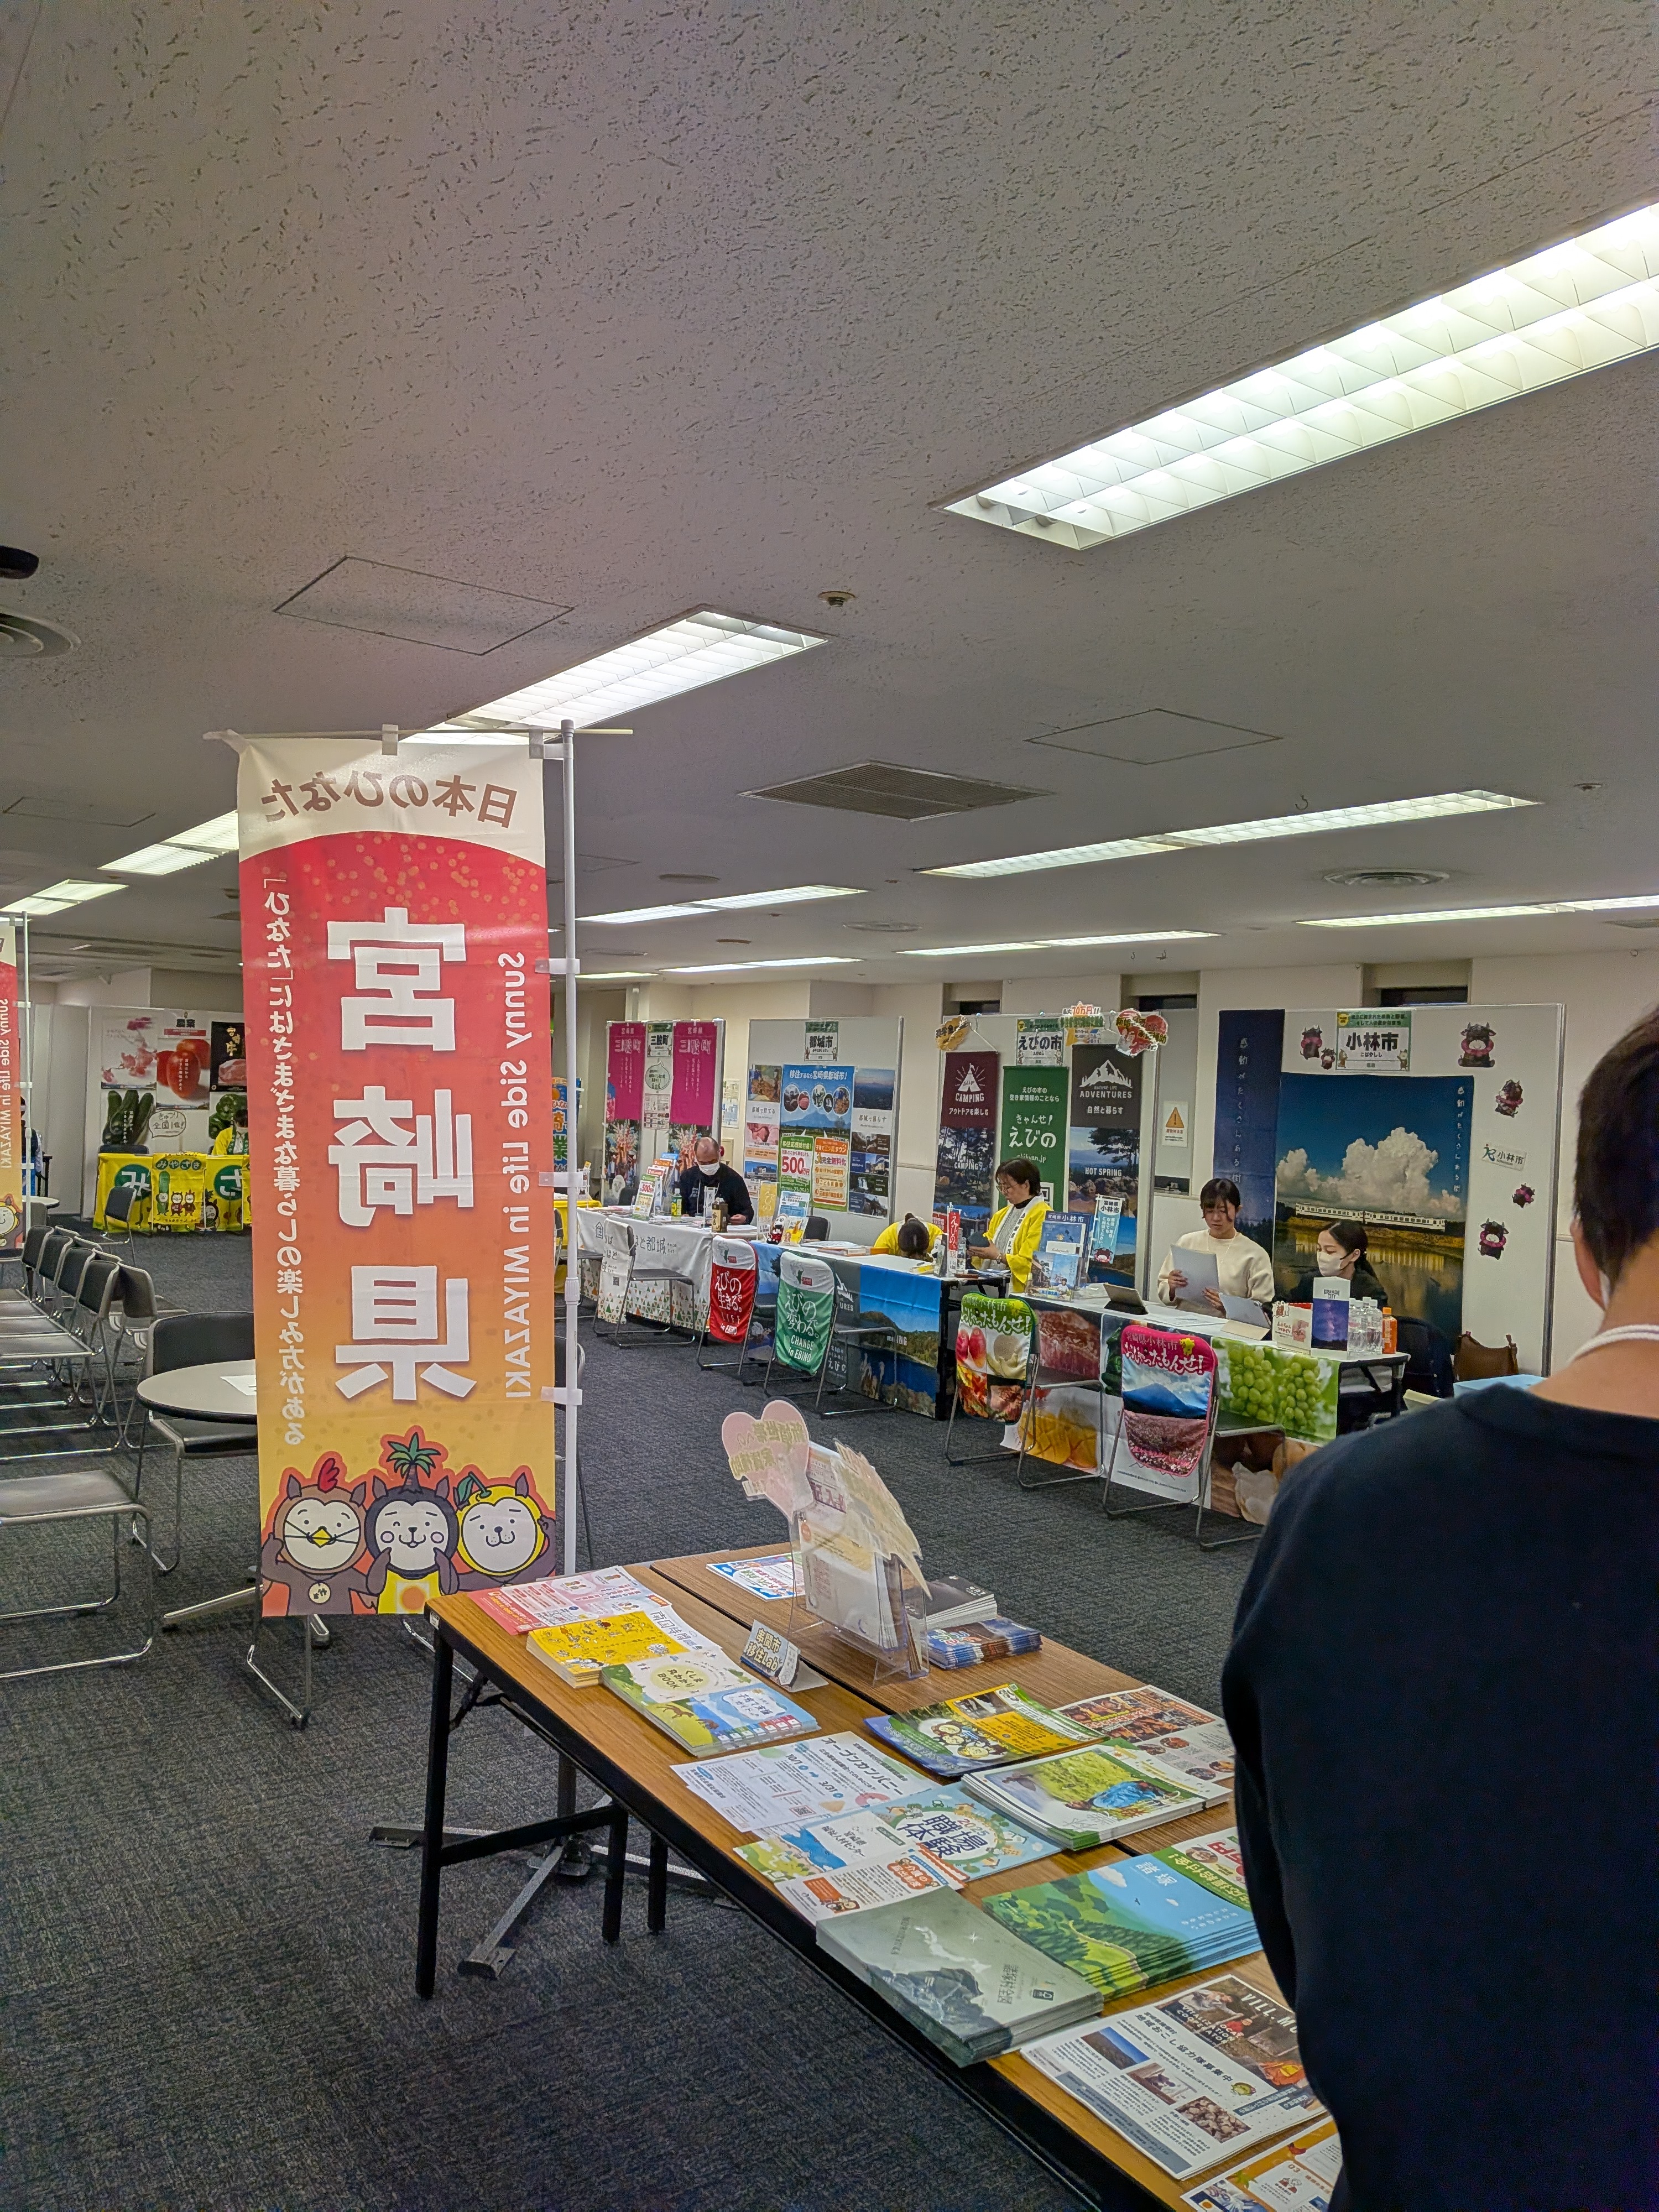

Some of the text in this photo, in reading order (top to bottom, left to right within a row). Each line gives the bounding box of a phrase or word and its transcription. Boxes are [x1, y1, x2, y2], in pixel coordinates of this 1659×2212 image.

[809, 1035, 833, 1048] 都城市
[1018, 1035, 1062, 1051] えびの市
[1345, 1032, 1399, 1051] 小林市
[955, 1092, 985, 1103] CAMPING
[1079, 1091, 1133, 1099] ADVENTURES
[948, 1107, 989, 1117] アウトドアを楽しむ
[1087, 1105, 1123, 1115] 自然と暮らす
[1232, 1037, 1248, 1183] 感動がたくさんある街
[1009, 1125, 1057, 1149] えびの
[1453, 1086, 1464, 1193] 感動がたくさんある街
[1497, 1151, 1524, 1165] 小林市
[1084, 1167, 1123, 1177] HOT SPRING
[1062, 1214, 1085, 1223] 小林市
[785, 1288, 817, 1320] えびの
[791, 1335, 814, 1350] CHANGE
[1126, 1331, 1178, 1350] 宮崎県小林市
[788, 1347, 812, 1363] in EBINO
[755, 1627, 781, 1653] 串間市
[747, 1641, 779, 1672] 移住Lab
[657, 1672, 681, 1690] BOOK
[667, 1668, 695, 1688] 丸わかり
[685, 1668, 704, 1683] くしま
[821, 1736, 904, 1795] オープンカンパニー
[818, 1780, 839, 1793] 3/31
[922, 1813, 988, 1852] 職場
[956, 1818, 990, 1837] 2025
[843, 1830, 868, 1846] 宮崎県
[896, 1823, 962, 1859] 体験
[1176, 2009, 1229, 2045] COOPERATOR
[1182, 2005, 1235, 2042] VITALIZATION
[1135, 2013, 1234, 2083] 地域おこし協力隊募集中
